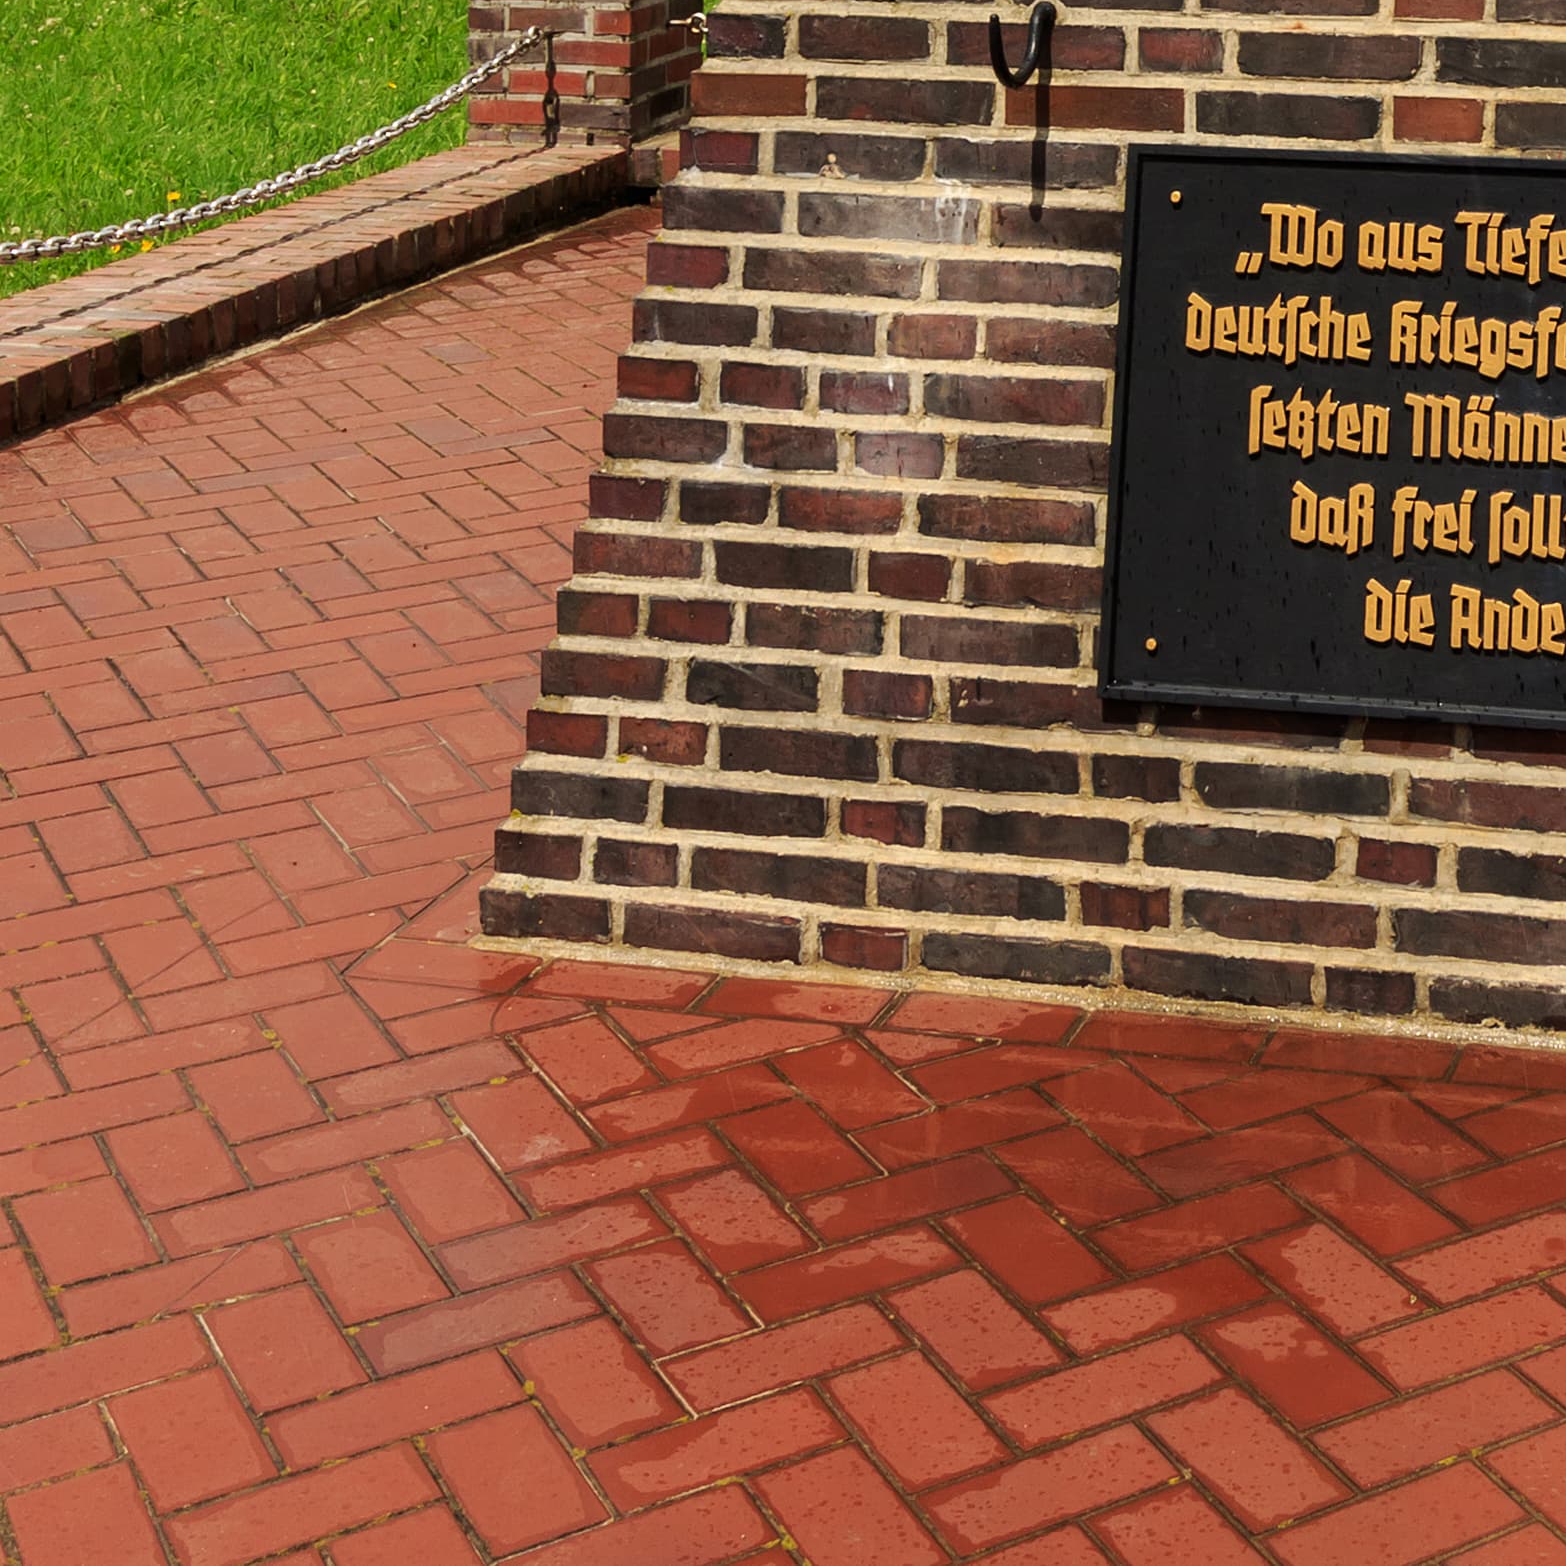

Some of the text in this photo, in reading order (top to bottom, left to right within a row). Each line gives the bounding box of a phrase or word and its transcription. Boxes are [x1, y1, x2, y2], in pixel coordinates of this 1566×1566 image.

[1357, 220, 1444, 272] aus
[1290, 480, 1375, 555] daß
[1391, 485, 1477, 557] frei
[1364, 578, 1435, 646] die
